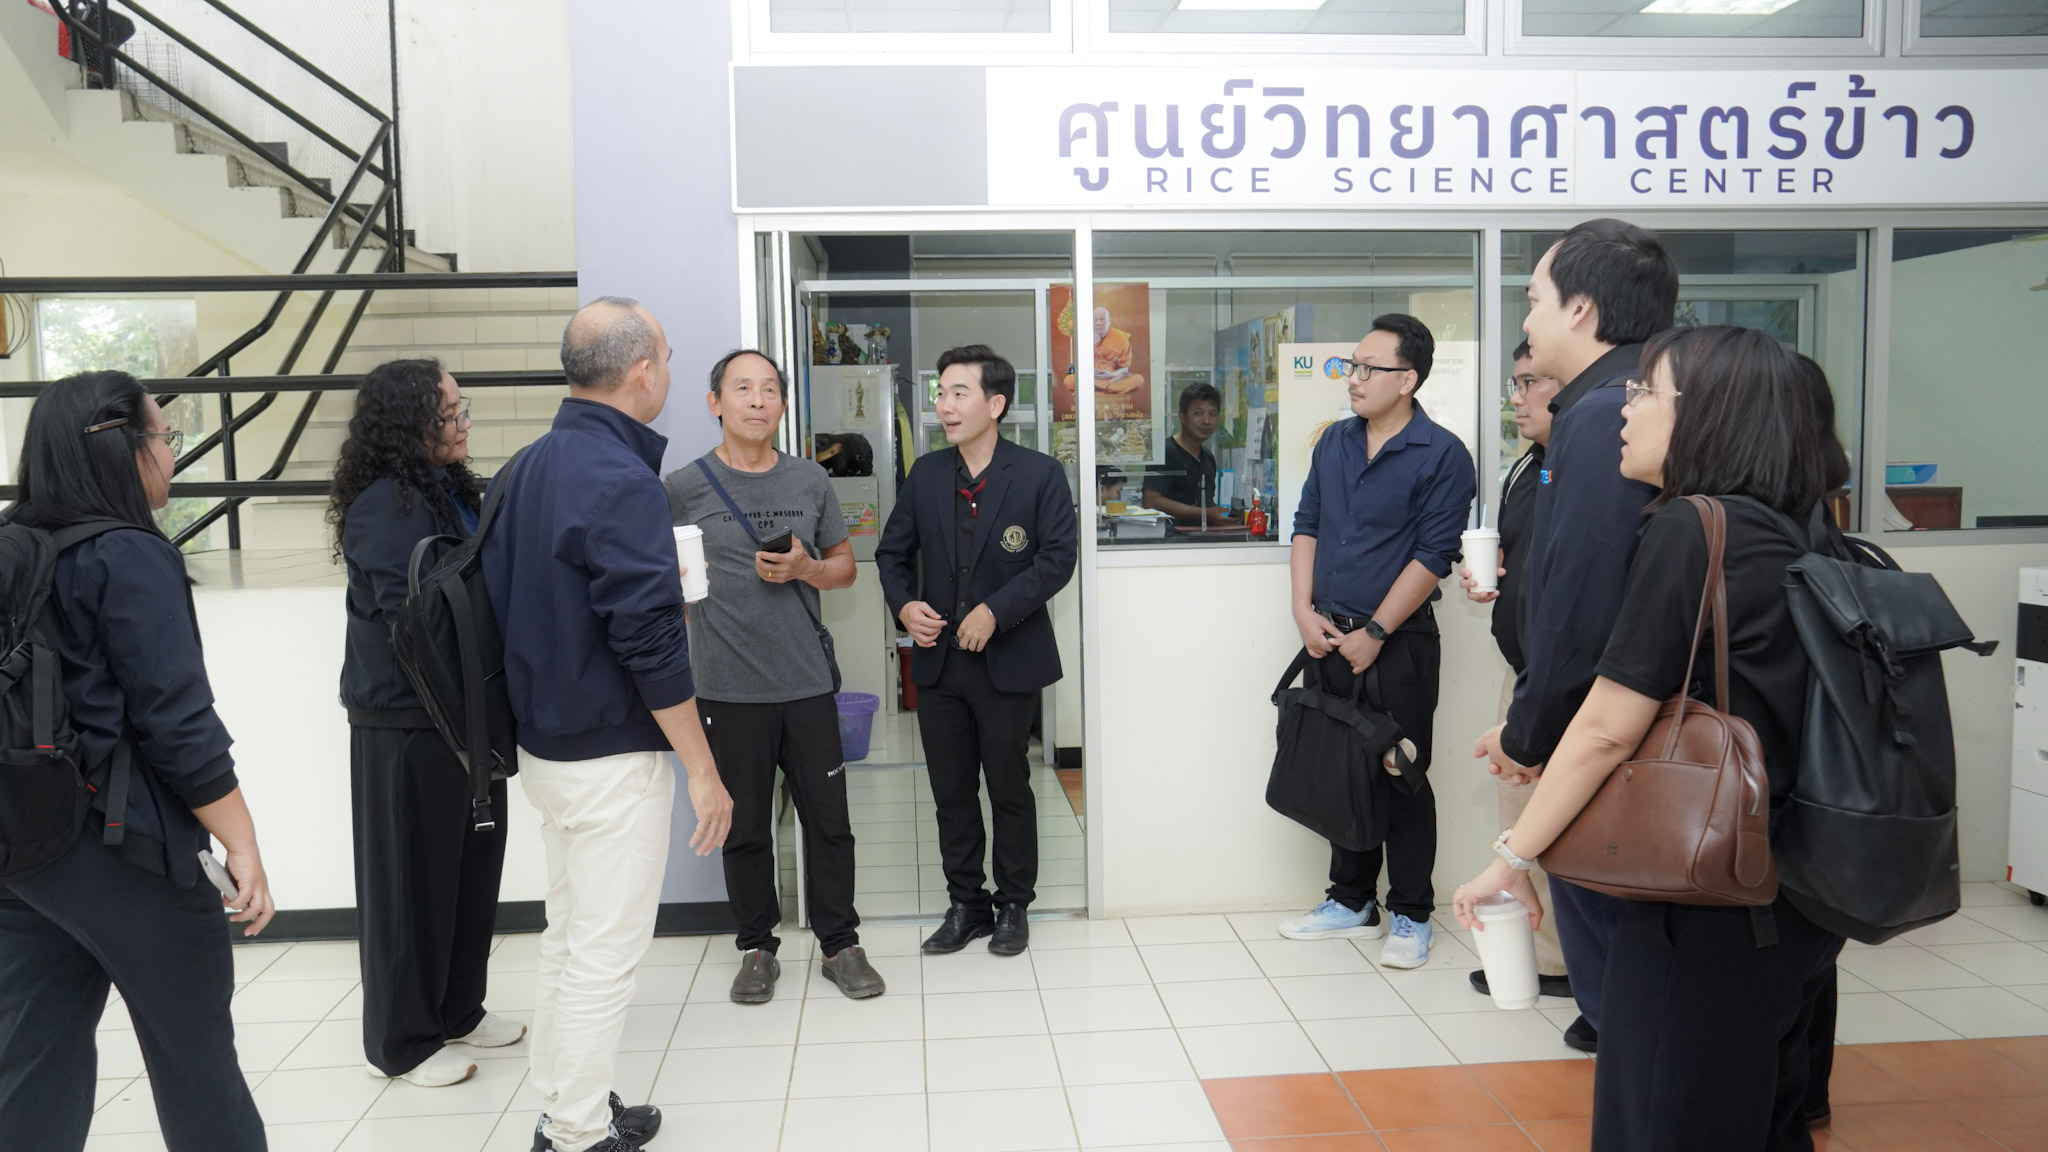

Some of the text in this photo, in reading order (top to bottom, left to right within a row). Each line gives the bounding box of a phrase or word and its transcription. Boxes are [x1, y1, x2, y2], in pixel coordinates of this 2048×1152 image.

[1058, 74, 1975, 192] ศูนย์วิทยาศาสตร์ข้าว
[1147, 167, 1834, 194] RICE SCIENCE CENTER
[1294, 356, 1313, 369] KU
[758, 520, 774, 529] CPS
